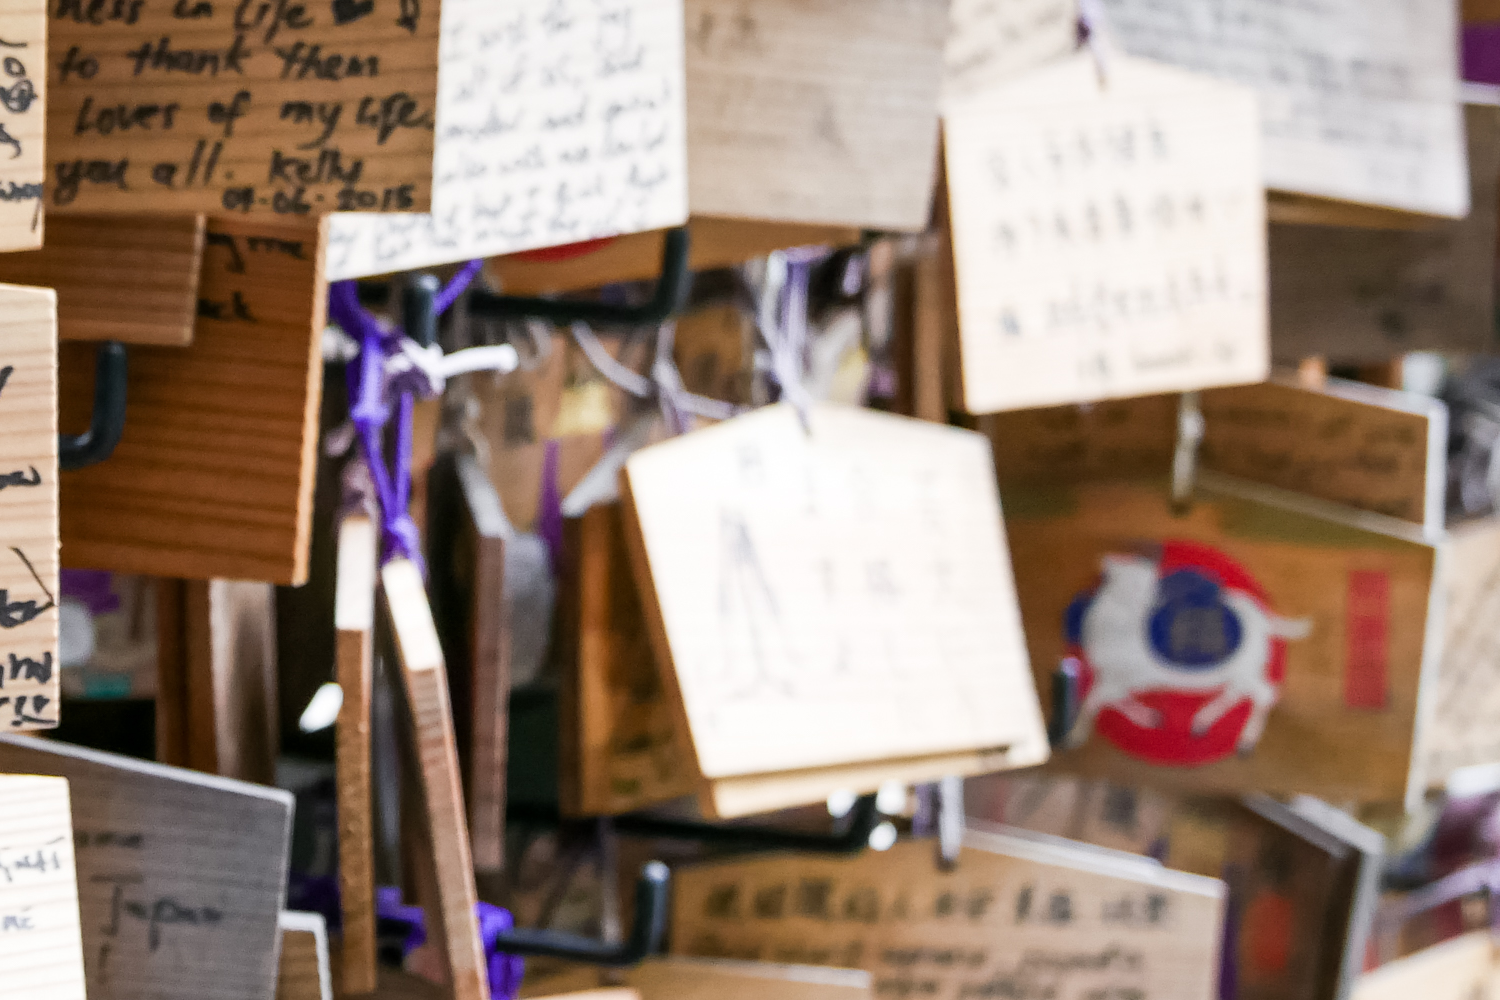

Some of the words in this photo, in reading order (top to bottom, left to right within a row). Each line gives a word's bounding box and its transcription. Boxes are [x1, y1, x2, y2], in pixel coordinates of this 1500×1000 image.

[56, 44, 100, 84] to
[125, 33, 253, 77] thank
[272, 41, 381, 82] them
[206, 89, 253, 138] of
[278, 98, 344, 151] my
